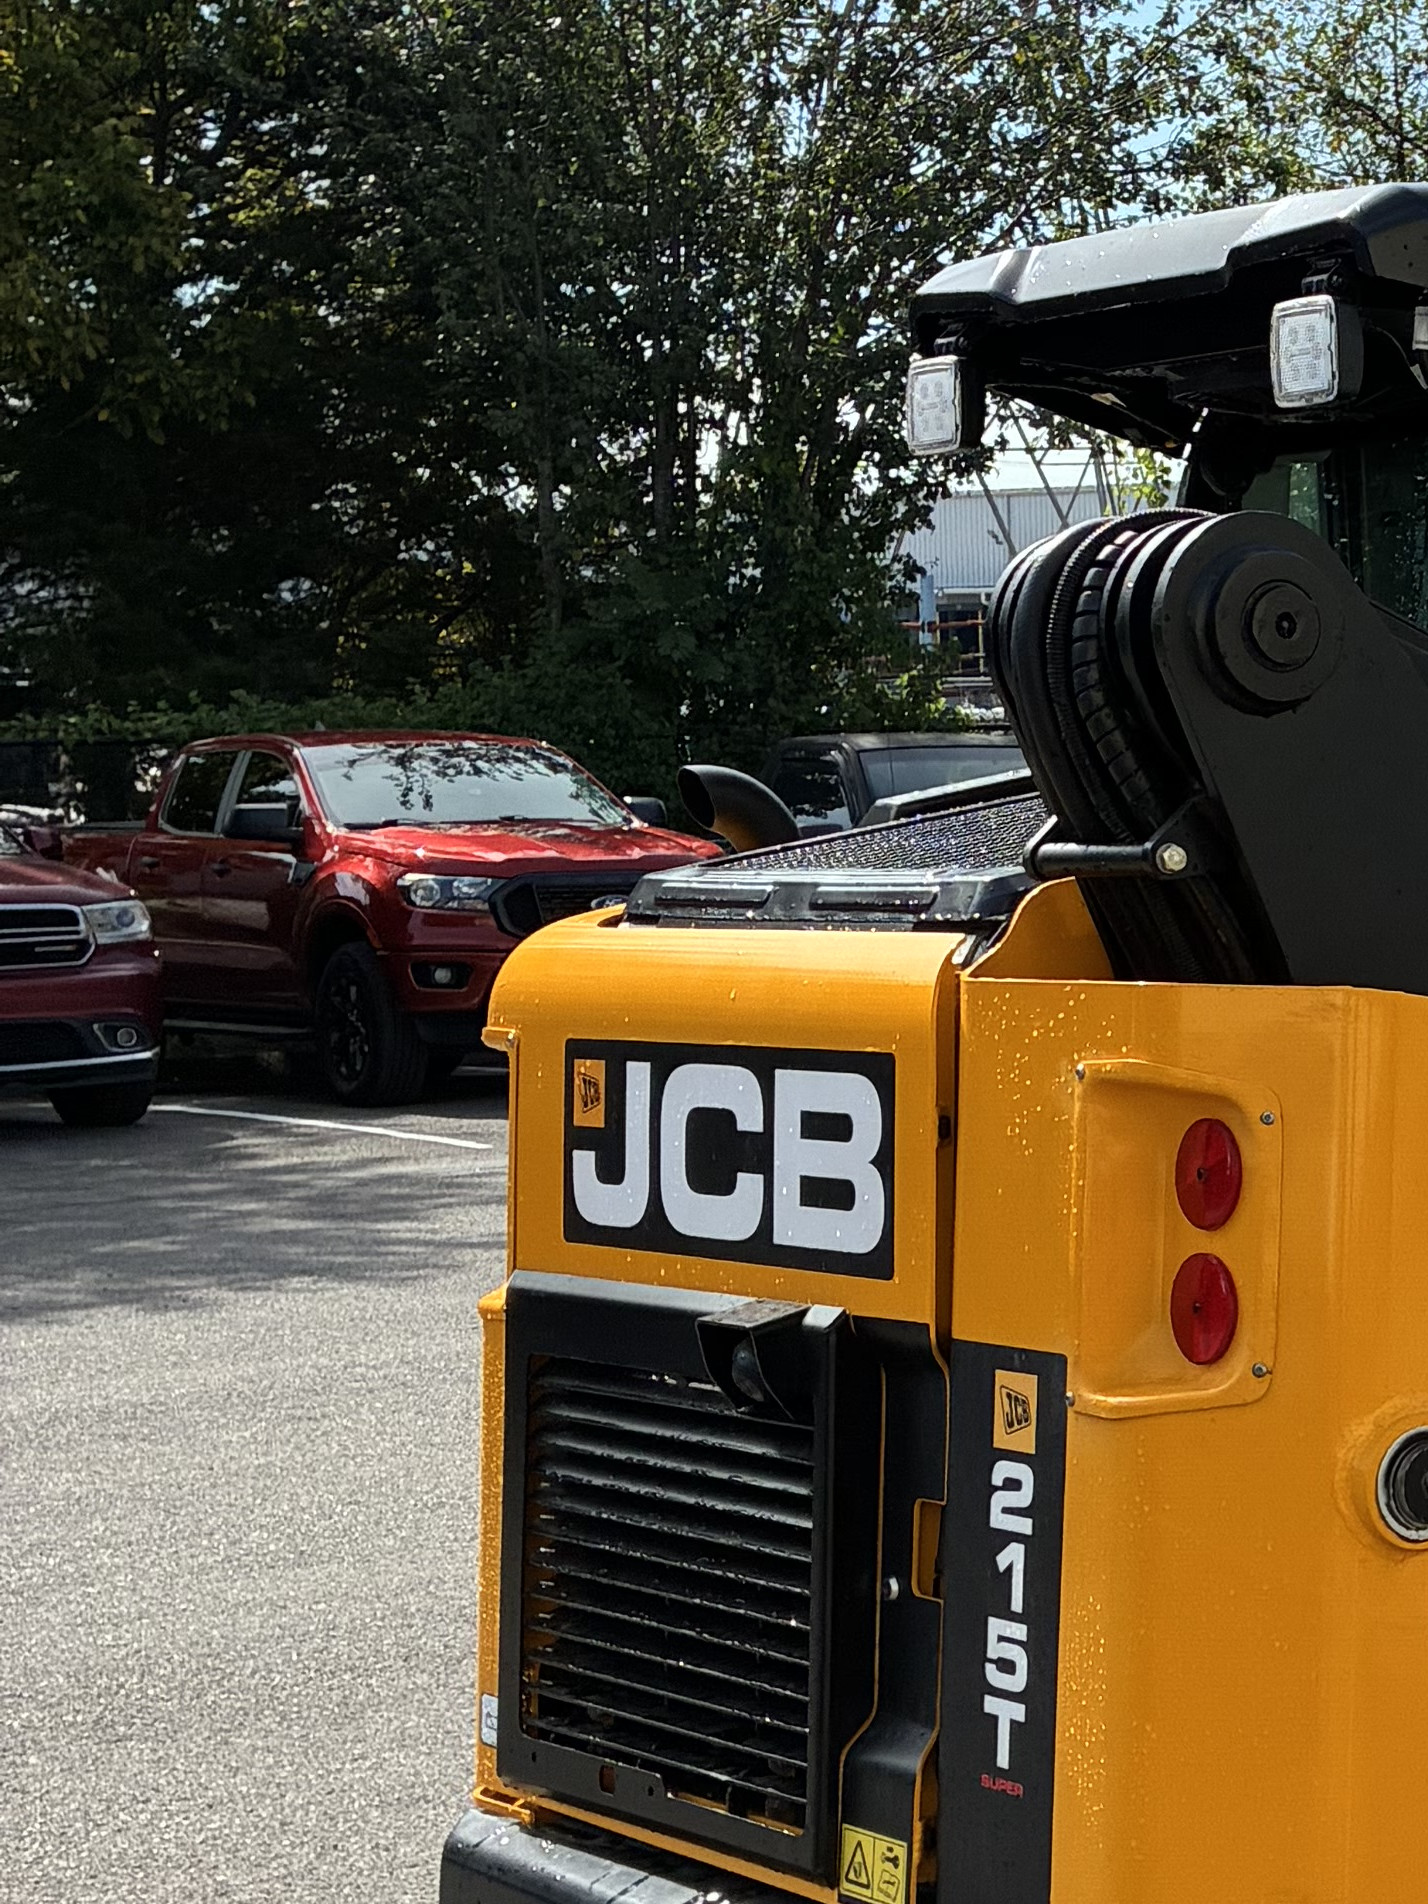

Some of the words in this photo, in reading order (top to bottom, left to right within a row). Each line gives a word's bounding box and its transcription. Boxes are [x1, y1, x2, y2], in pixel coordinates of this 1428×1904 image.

[573, 1060, 883, 1254] JCB
[1006, 1391, 1029, 1428] JCB
[985, 1460, 1034, 1769] 215T
[980, 1774, 1023, 1798] SUPER
